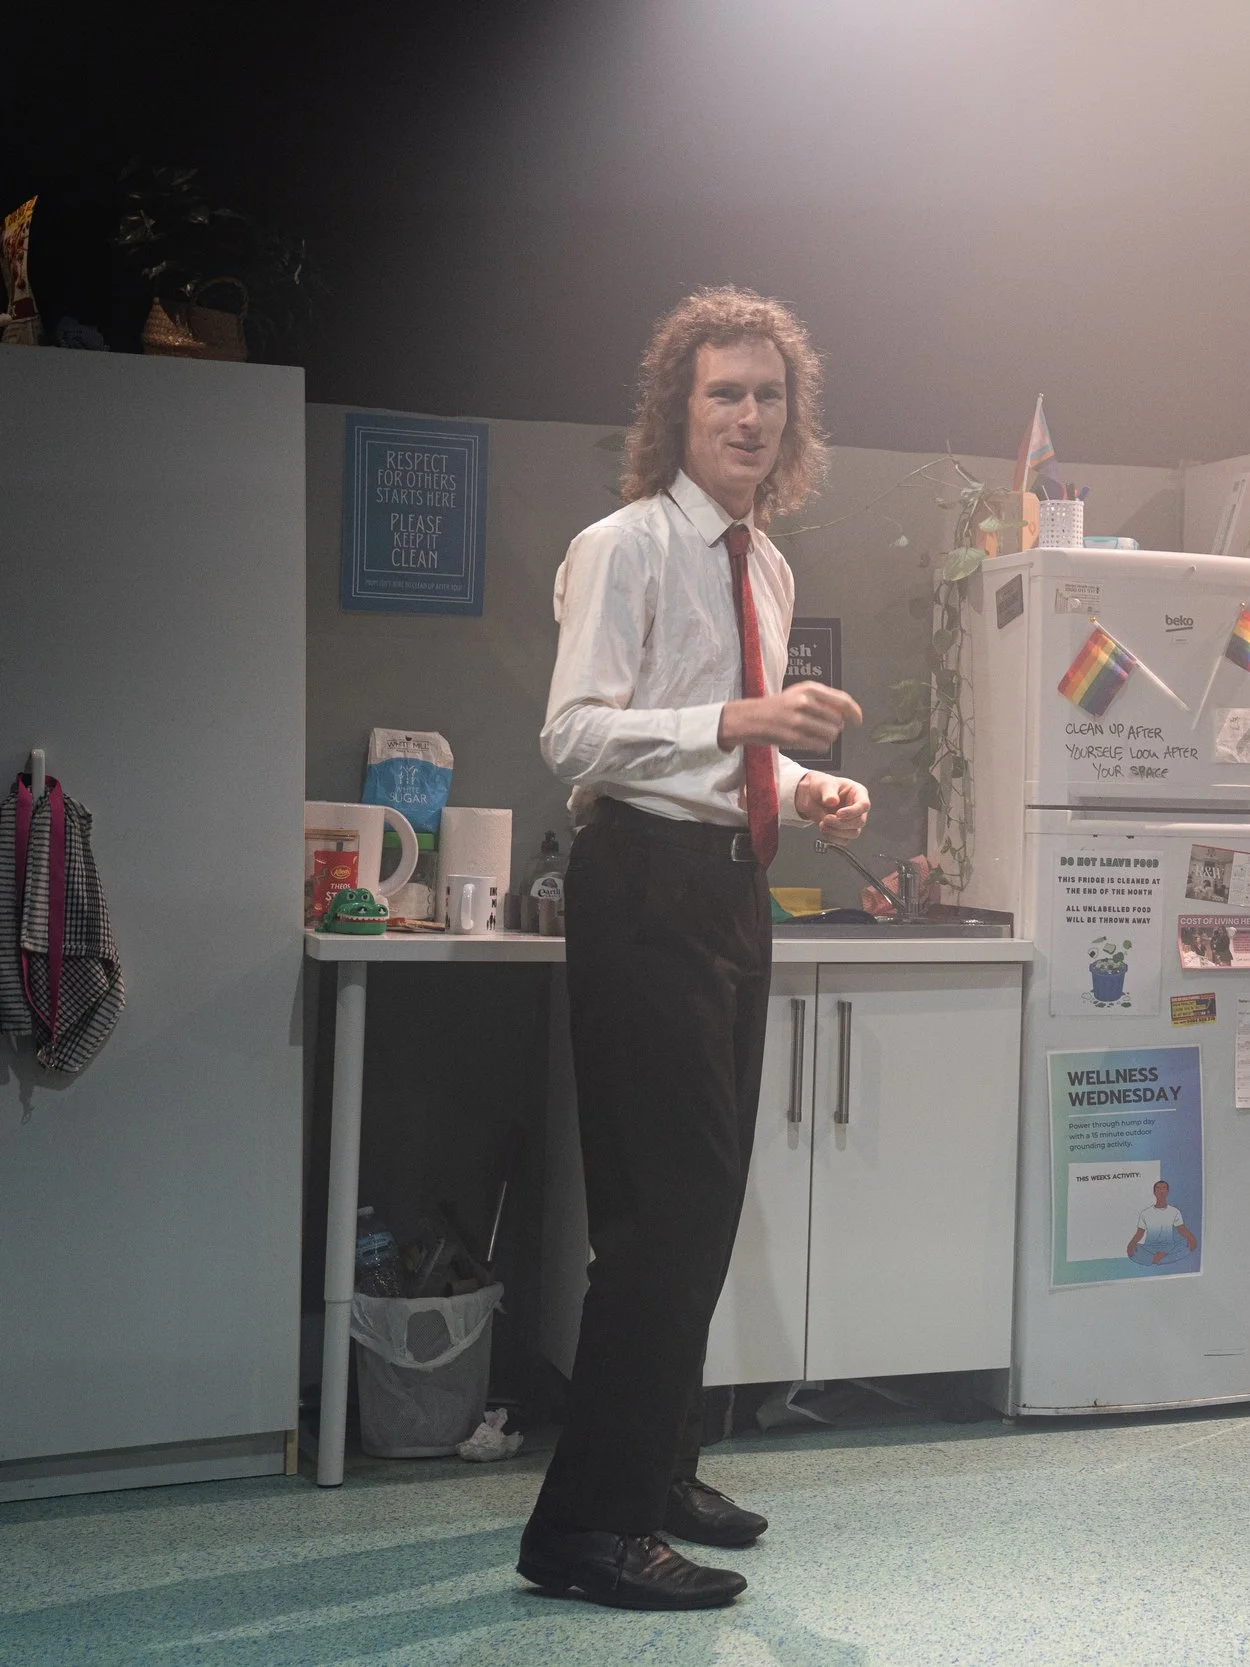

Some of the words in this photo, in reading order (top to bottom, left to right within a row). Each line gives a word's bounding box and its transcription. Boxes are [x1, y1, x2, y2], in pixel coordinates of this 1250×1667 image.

[386, 450, 448, 473] RESPECT
[377, 469, 403, 487] FOR
[406, 471, 456, 491] OTHERS
[376, 488, 423, 506] STARTS
[427, 491, 456, 509] HERE
[390, 513, 442, 534] PLEASE
[393, 532, 424, 548] KEEP
[427, 534, 438, 550] IT
[391, 548, 439, 569] CLEAN
[1165, 614, 1194, 626] beko
[789, 644, 811, 657] sh
[787, 662, 822, 676] nds
[1065, 722, 1104, 736] CLEAN
[1109, 723, 1124, 738] UP
[1127, 726, 1164, 742] AFTER
[1164, 746, 1199, 760] AFTER
[1092, 762, 1124, 780] YOUR
[395, 786, 420, 794] WHITE
[389, 793, 428, 804] SUGAR
[1060, 856, 1074, 866] DO
[1077, 857, 1098, 867] NOT
[1099, 857, 1132, 868] LEAVE
[1133, 858, 1159, 868] FOOD
[1078, 876, 1105, 884] FRIDGE
[1117, 877, 1150, 885] CLEANED
[1180, 917, 1201, 925] COST
[1214, 917, 1239, 925] LIVING
[1067, 1067, 1159, 1086] WELLNESS
[1068, 1086, 1182, 1107] WEDNESDAY
[1068, 1122, 1090, 1130] Power
[1092, 1120, 1120, 1129] through
[1121, 1119, 1142, 1127] hump
[1143, 1118, 1156, 1126] day
[1099, 1130, 1125, 1138] minute
[1125, 1129, 1152, 1137] outdoor
[1069, 1142, 1106, 1152] grounding
[1107, 1140, 1133, 1149] activity.
